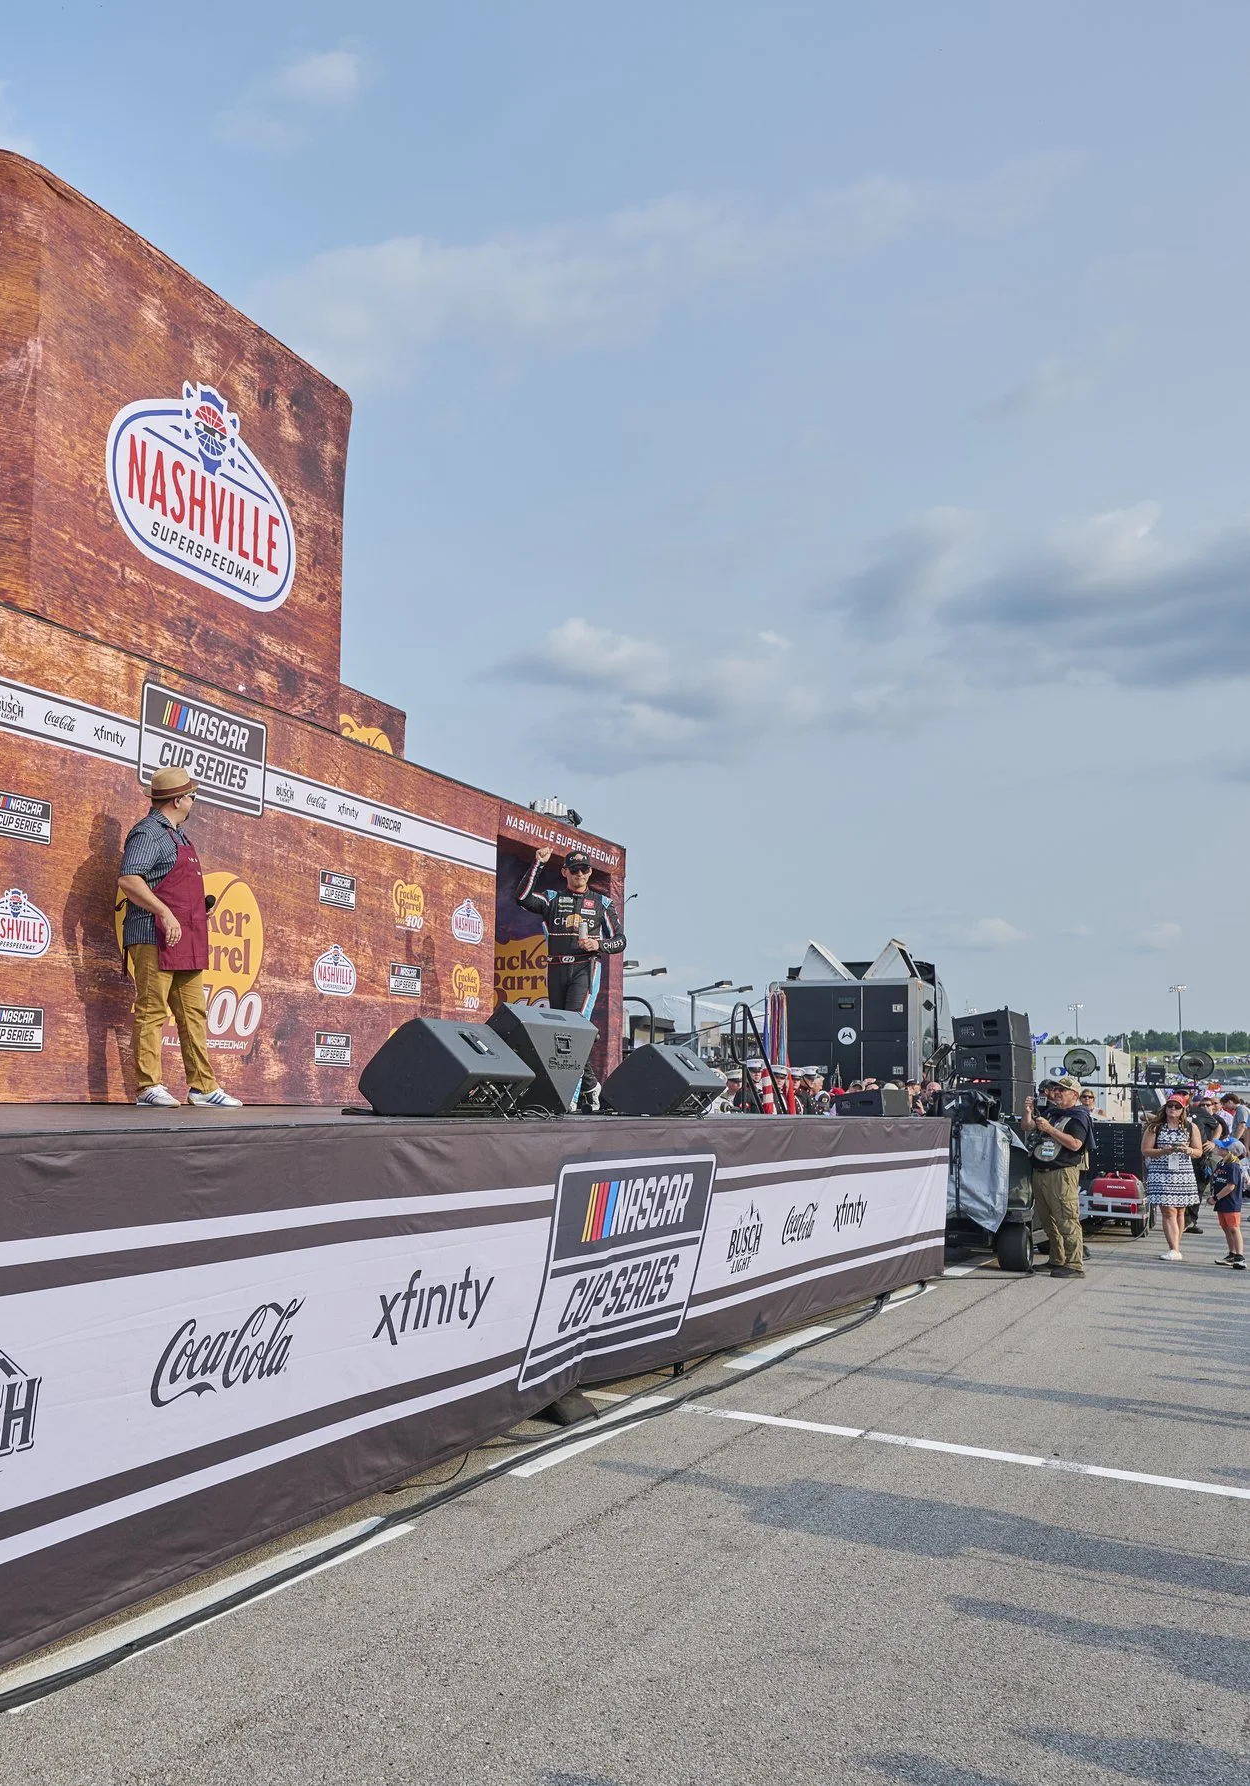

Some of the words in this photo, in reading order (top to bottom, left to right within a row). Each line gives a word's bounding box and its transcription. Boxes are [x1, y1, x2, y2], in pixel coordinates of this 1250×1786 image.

[128, 433, 280, 576] NASHVILLE
[150, 521, 260, 587] SUPERSPEEDWAY
[93, 725, 127, 747] xfinity
[184, 708, 250, 752] NASCAR
[159, 741, 193, 768] CUP
[193, 753, 249, 790] SERIES
[10, 799, 43, 817] NASCAR
[338, 803, 359, 820] xfinity
[14, 817, 43, 834] SERIES
[376, 815, 402, 834] NASCAR
[506, 814, 555, 842] NASHVILLE
[555, 833, 620, 867] SUPERSPEEDWAY
[394, 883, 422, 907] Cracker
[405, 915, 424, 929] 400
[318, 964, 353, 985] NASHVILLE
[1, 1009, 35, 1024] NASCAR
[6, 1029, 35, 1041] SERIES
[614, 1173, 693, 1236] NASCAR
[833, 1193, 867, 1233] xfinity
[726, 1223, 763, 1262] BUSCH
[730, 1256, 752, 1274] LIGHT
[373, 1265, 495, 1346] xfinity
[558, 1268, 609, 1333] CUP
[610, 1254, 680, 1317] SERIES
